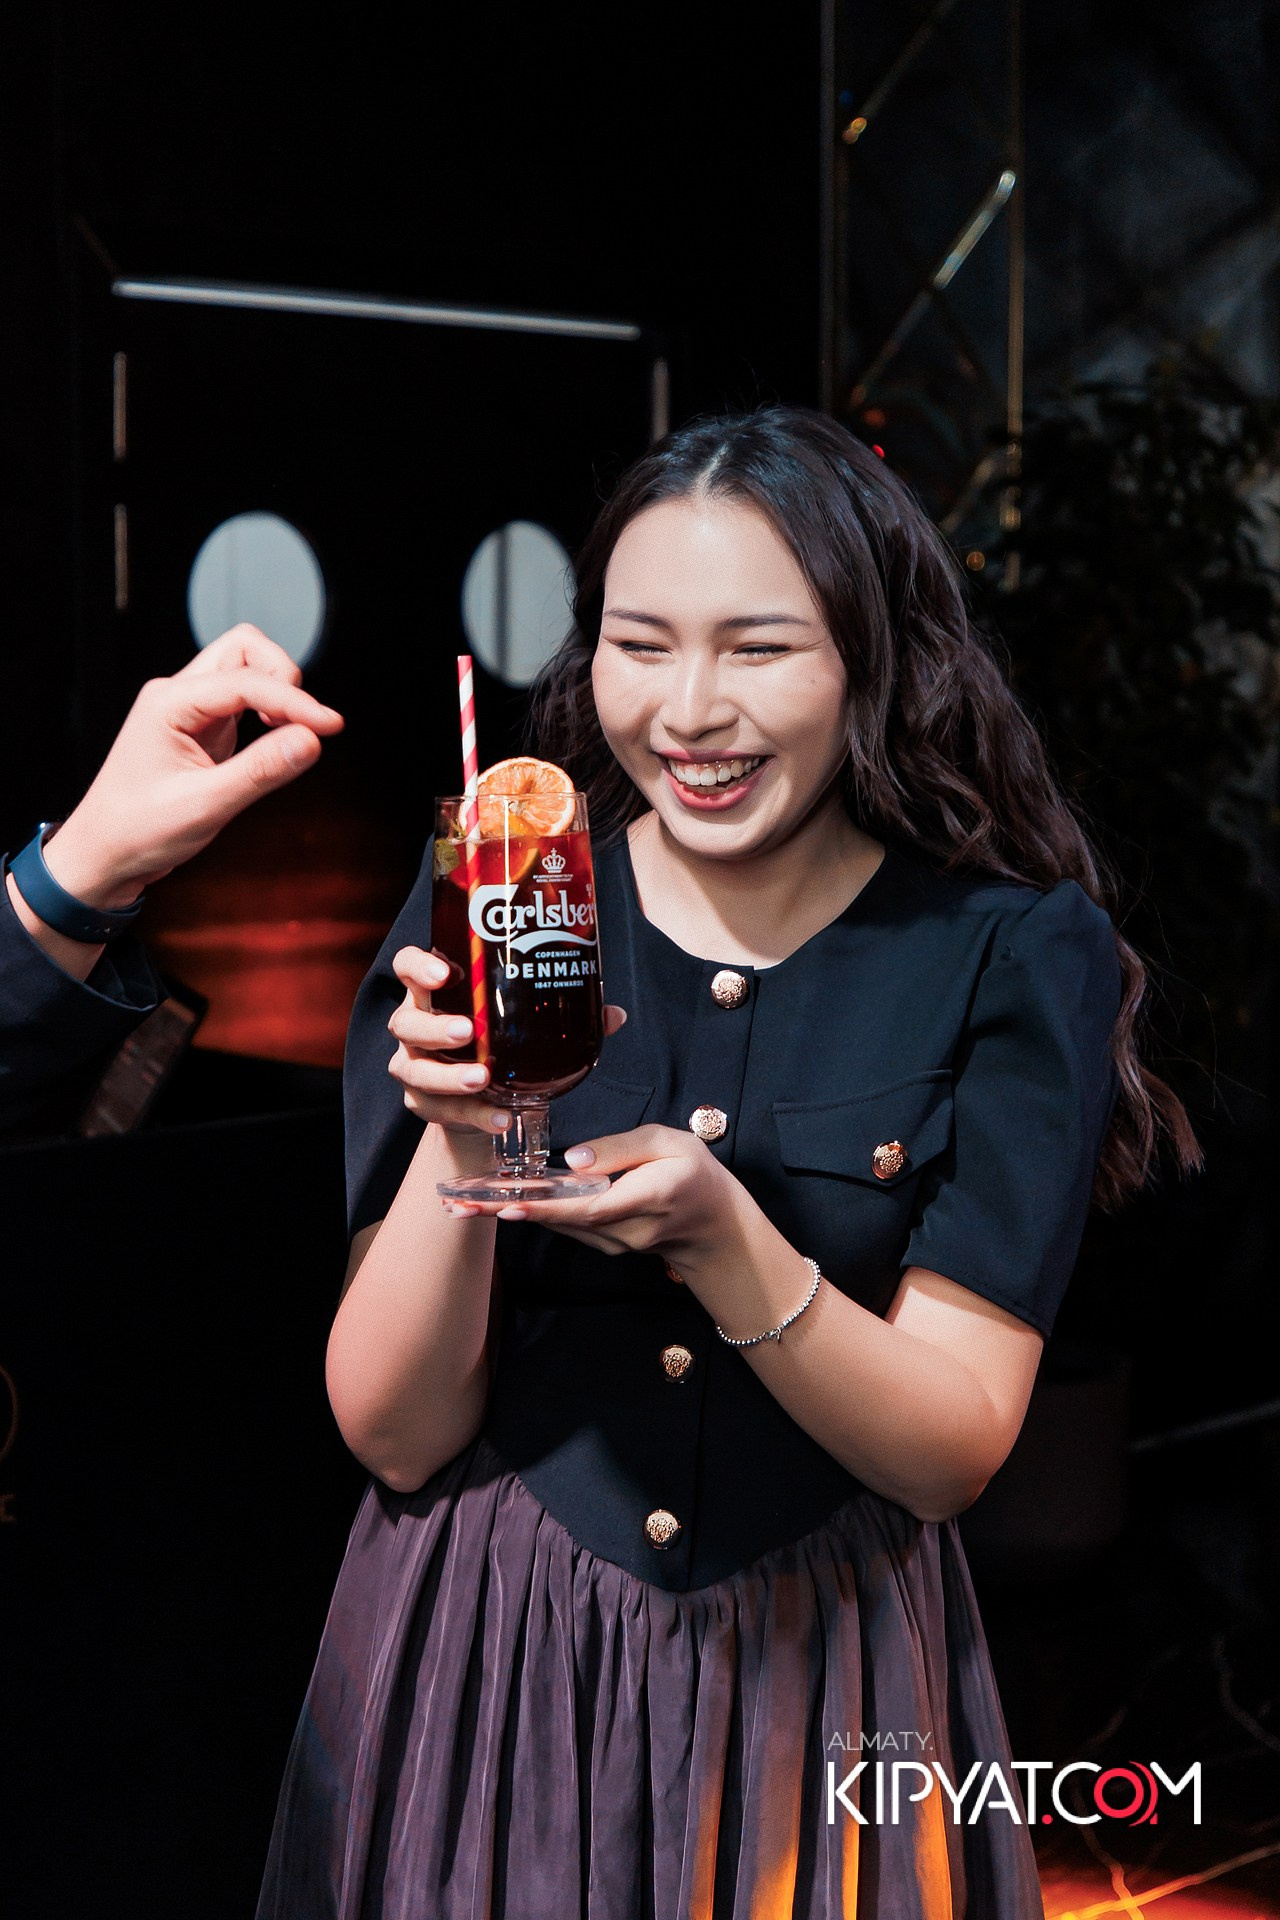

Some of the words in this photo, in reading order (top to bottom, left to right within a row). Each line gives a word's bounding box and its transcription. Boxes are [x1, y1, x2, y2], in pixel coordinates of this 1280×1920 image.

[468, 884, 596, 942] Carlsber
[535, 950, 581, 959] COPENHAGEN
[505, 960, 597, 979] DENMARK
[534, 981, 551, 989] 1847
